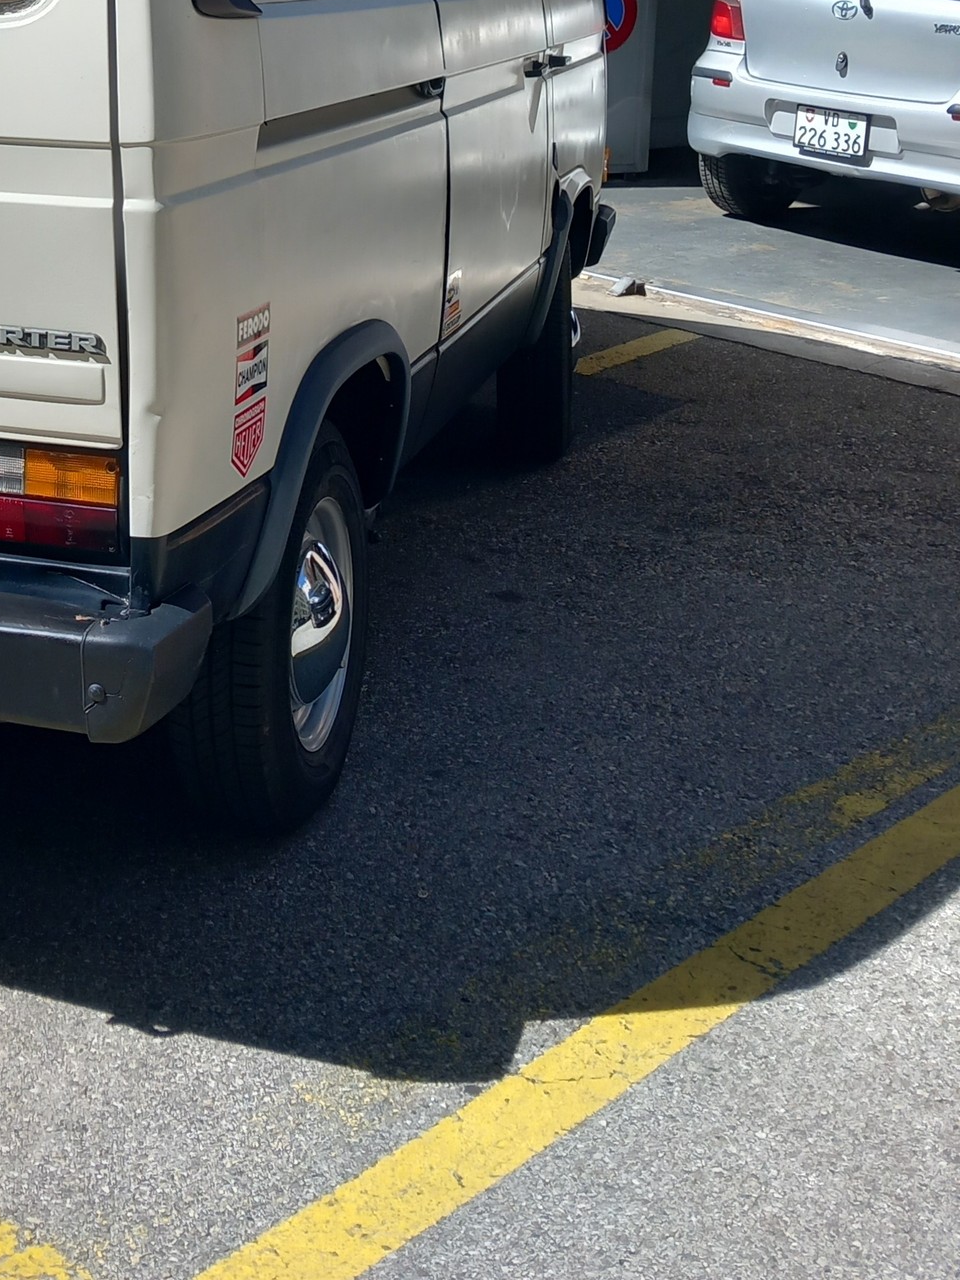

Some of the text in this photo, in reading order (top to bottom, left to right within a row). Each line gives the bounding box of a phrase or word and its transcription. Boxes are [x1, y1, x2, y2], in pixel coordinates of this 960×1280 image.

[824, 111, 839, 127] VD
[797, 126, 826, 148] 226
[831, 131, 861, 154] 336
[238, 309, 269, 342] FERODO
[238, 358, 267, 387] CHAMPION
[235, 421, 261, 465] HEUER
